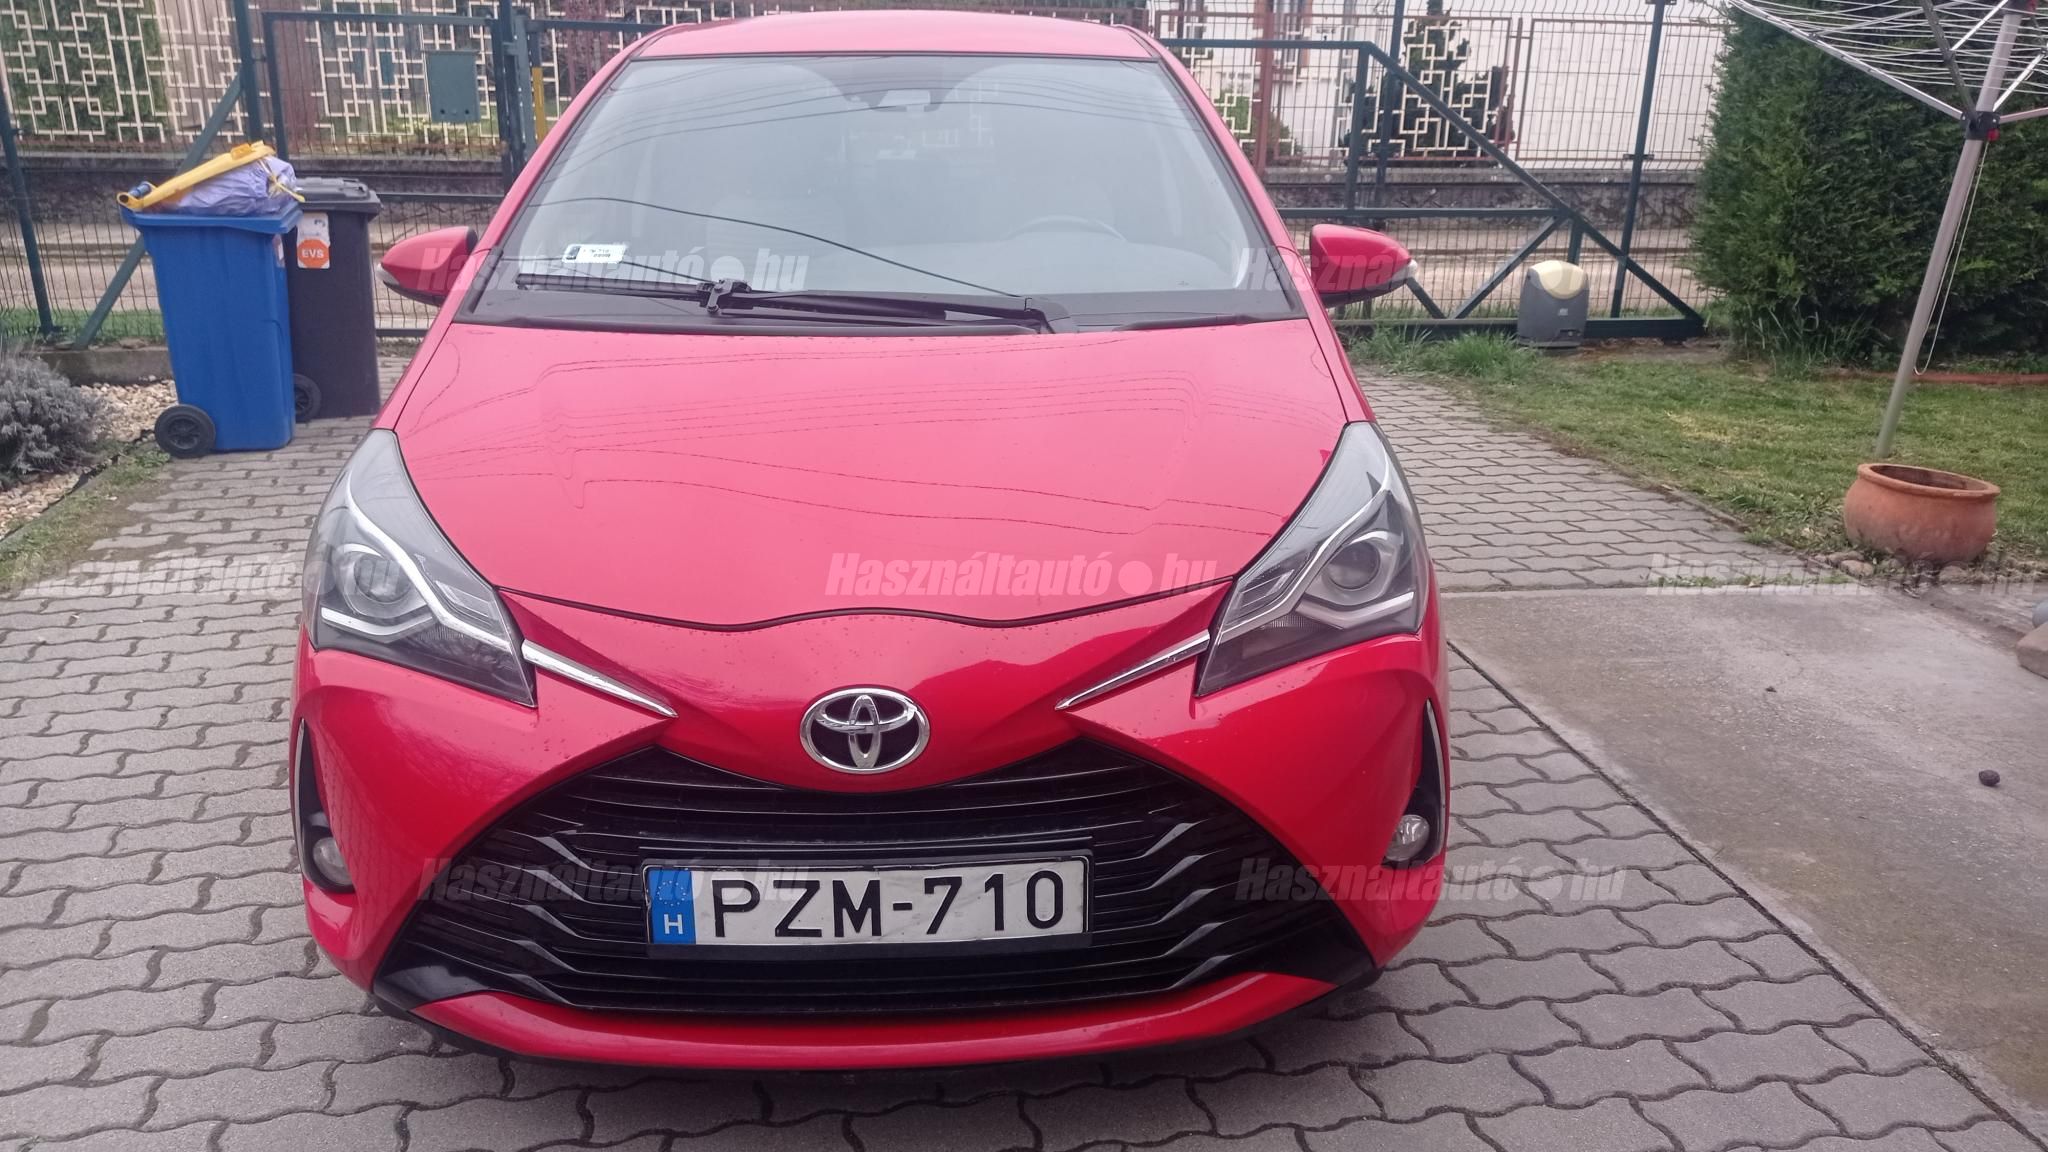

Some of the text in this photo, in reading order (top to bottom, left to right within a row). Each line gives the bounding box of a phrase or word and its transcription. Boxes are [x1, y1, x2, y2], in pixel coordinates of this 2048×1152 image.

[301, 248, 325, 258] EVS
[711, 870, 1064, 938] PZM-710
[663, 913, 684, 935] H
